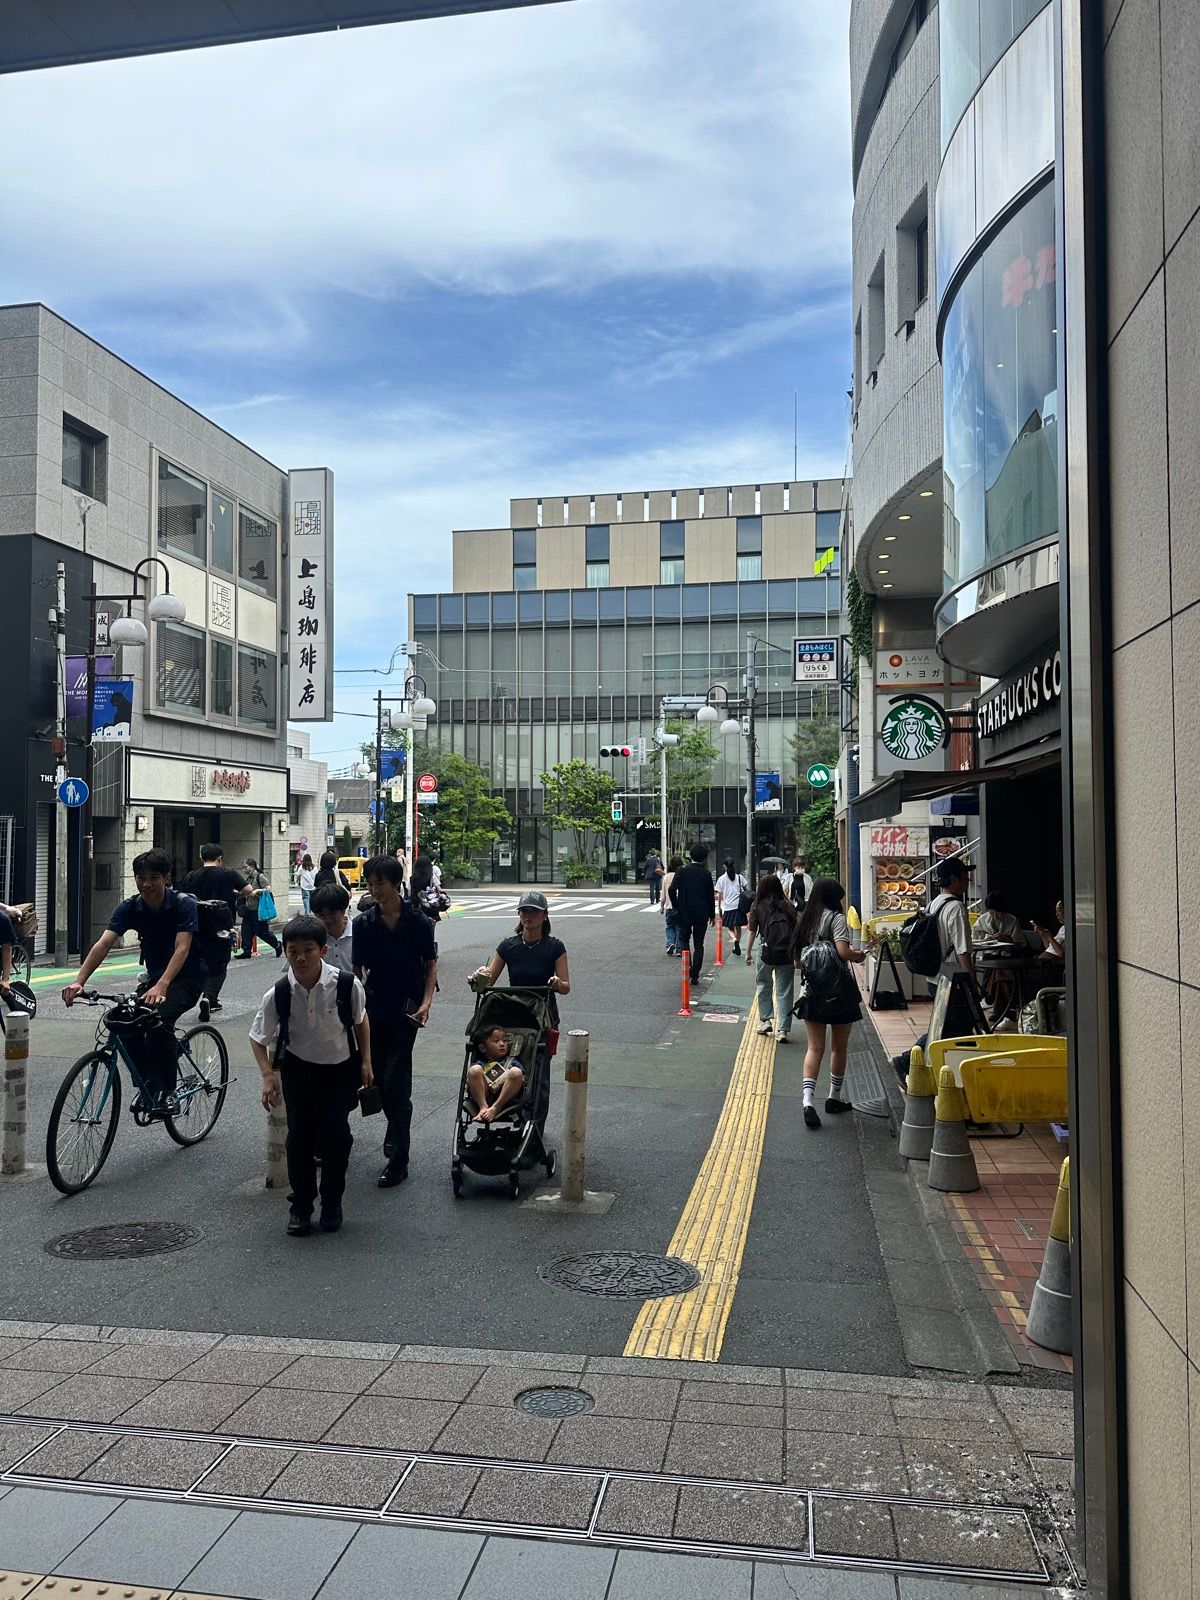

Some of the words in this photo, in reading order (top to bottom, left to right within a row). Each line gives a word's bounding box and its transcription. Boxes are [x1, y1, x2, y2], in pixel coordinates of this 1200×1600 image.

[97, 615, 108, 643] 成城
[298, 558, 319, 707] 上島珈琲店
[879, 668, 942, 679] ホットヨガ
[977, 666, 1039, 739] STARBUCKS
[40, 774, 54, 783] THE
[871, 827, 906, 842] ワイン
